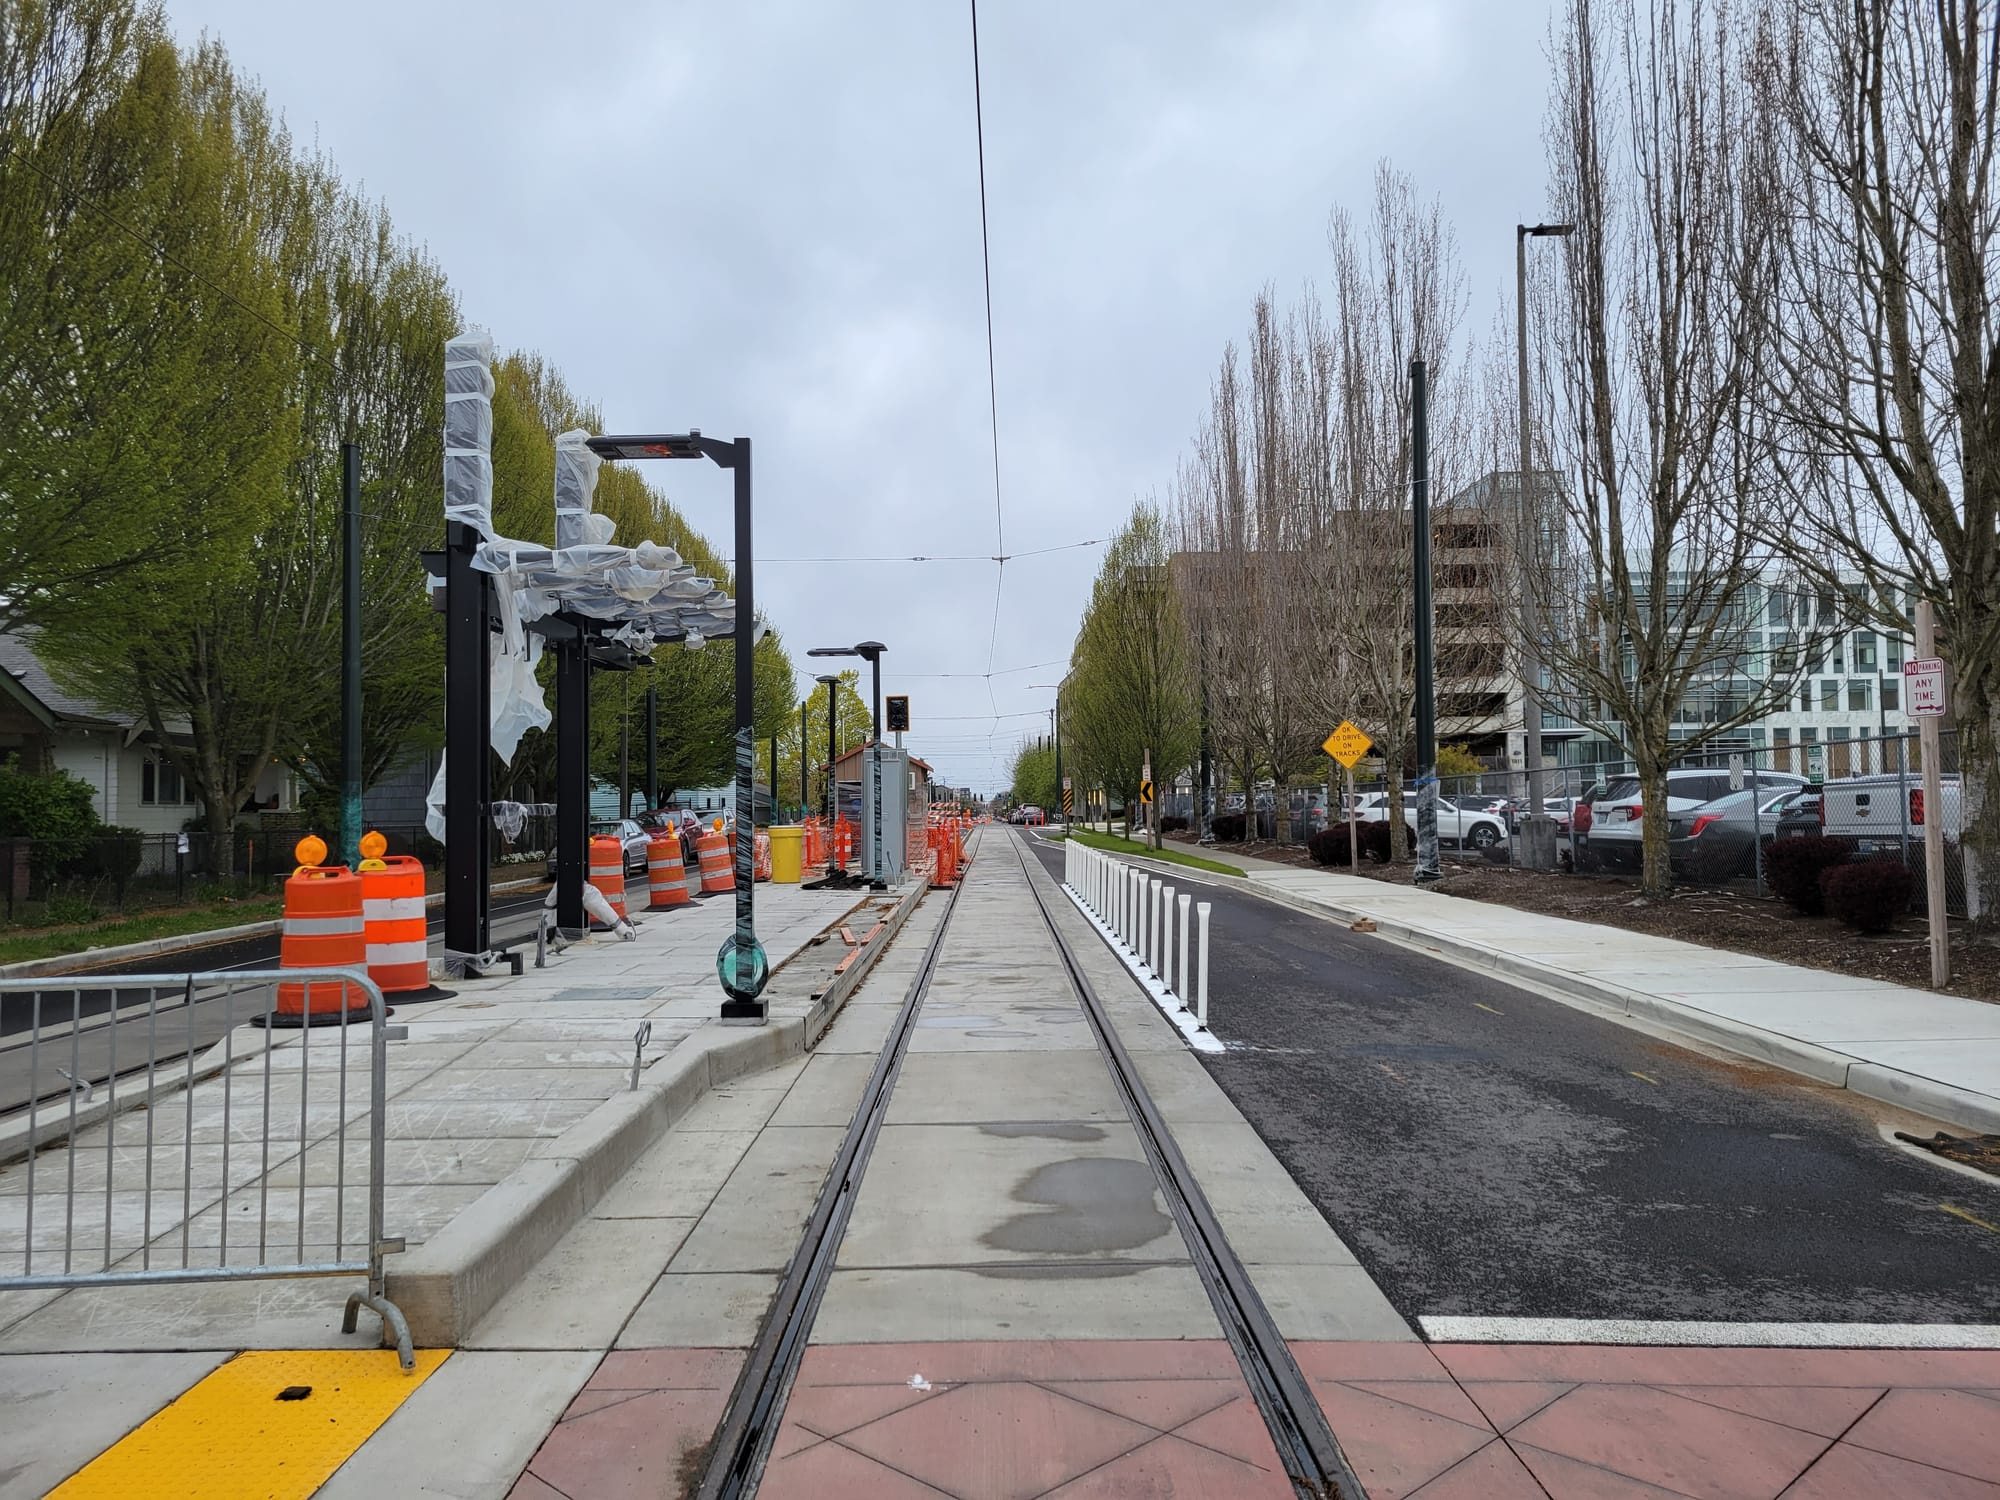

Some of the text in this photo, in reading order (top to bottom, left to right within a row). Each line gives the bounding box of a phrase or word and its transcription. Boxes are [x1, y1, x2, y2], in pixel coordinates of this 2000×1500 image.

[1906, 662, 1940, 674] NO PARKING
[1915, 678, 1933, 688] ANY
[1914, 691, 1935, 701] TIME
